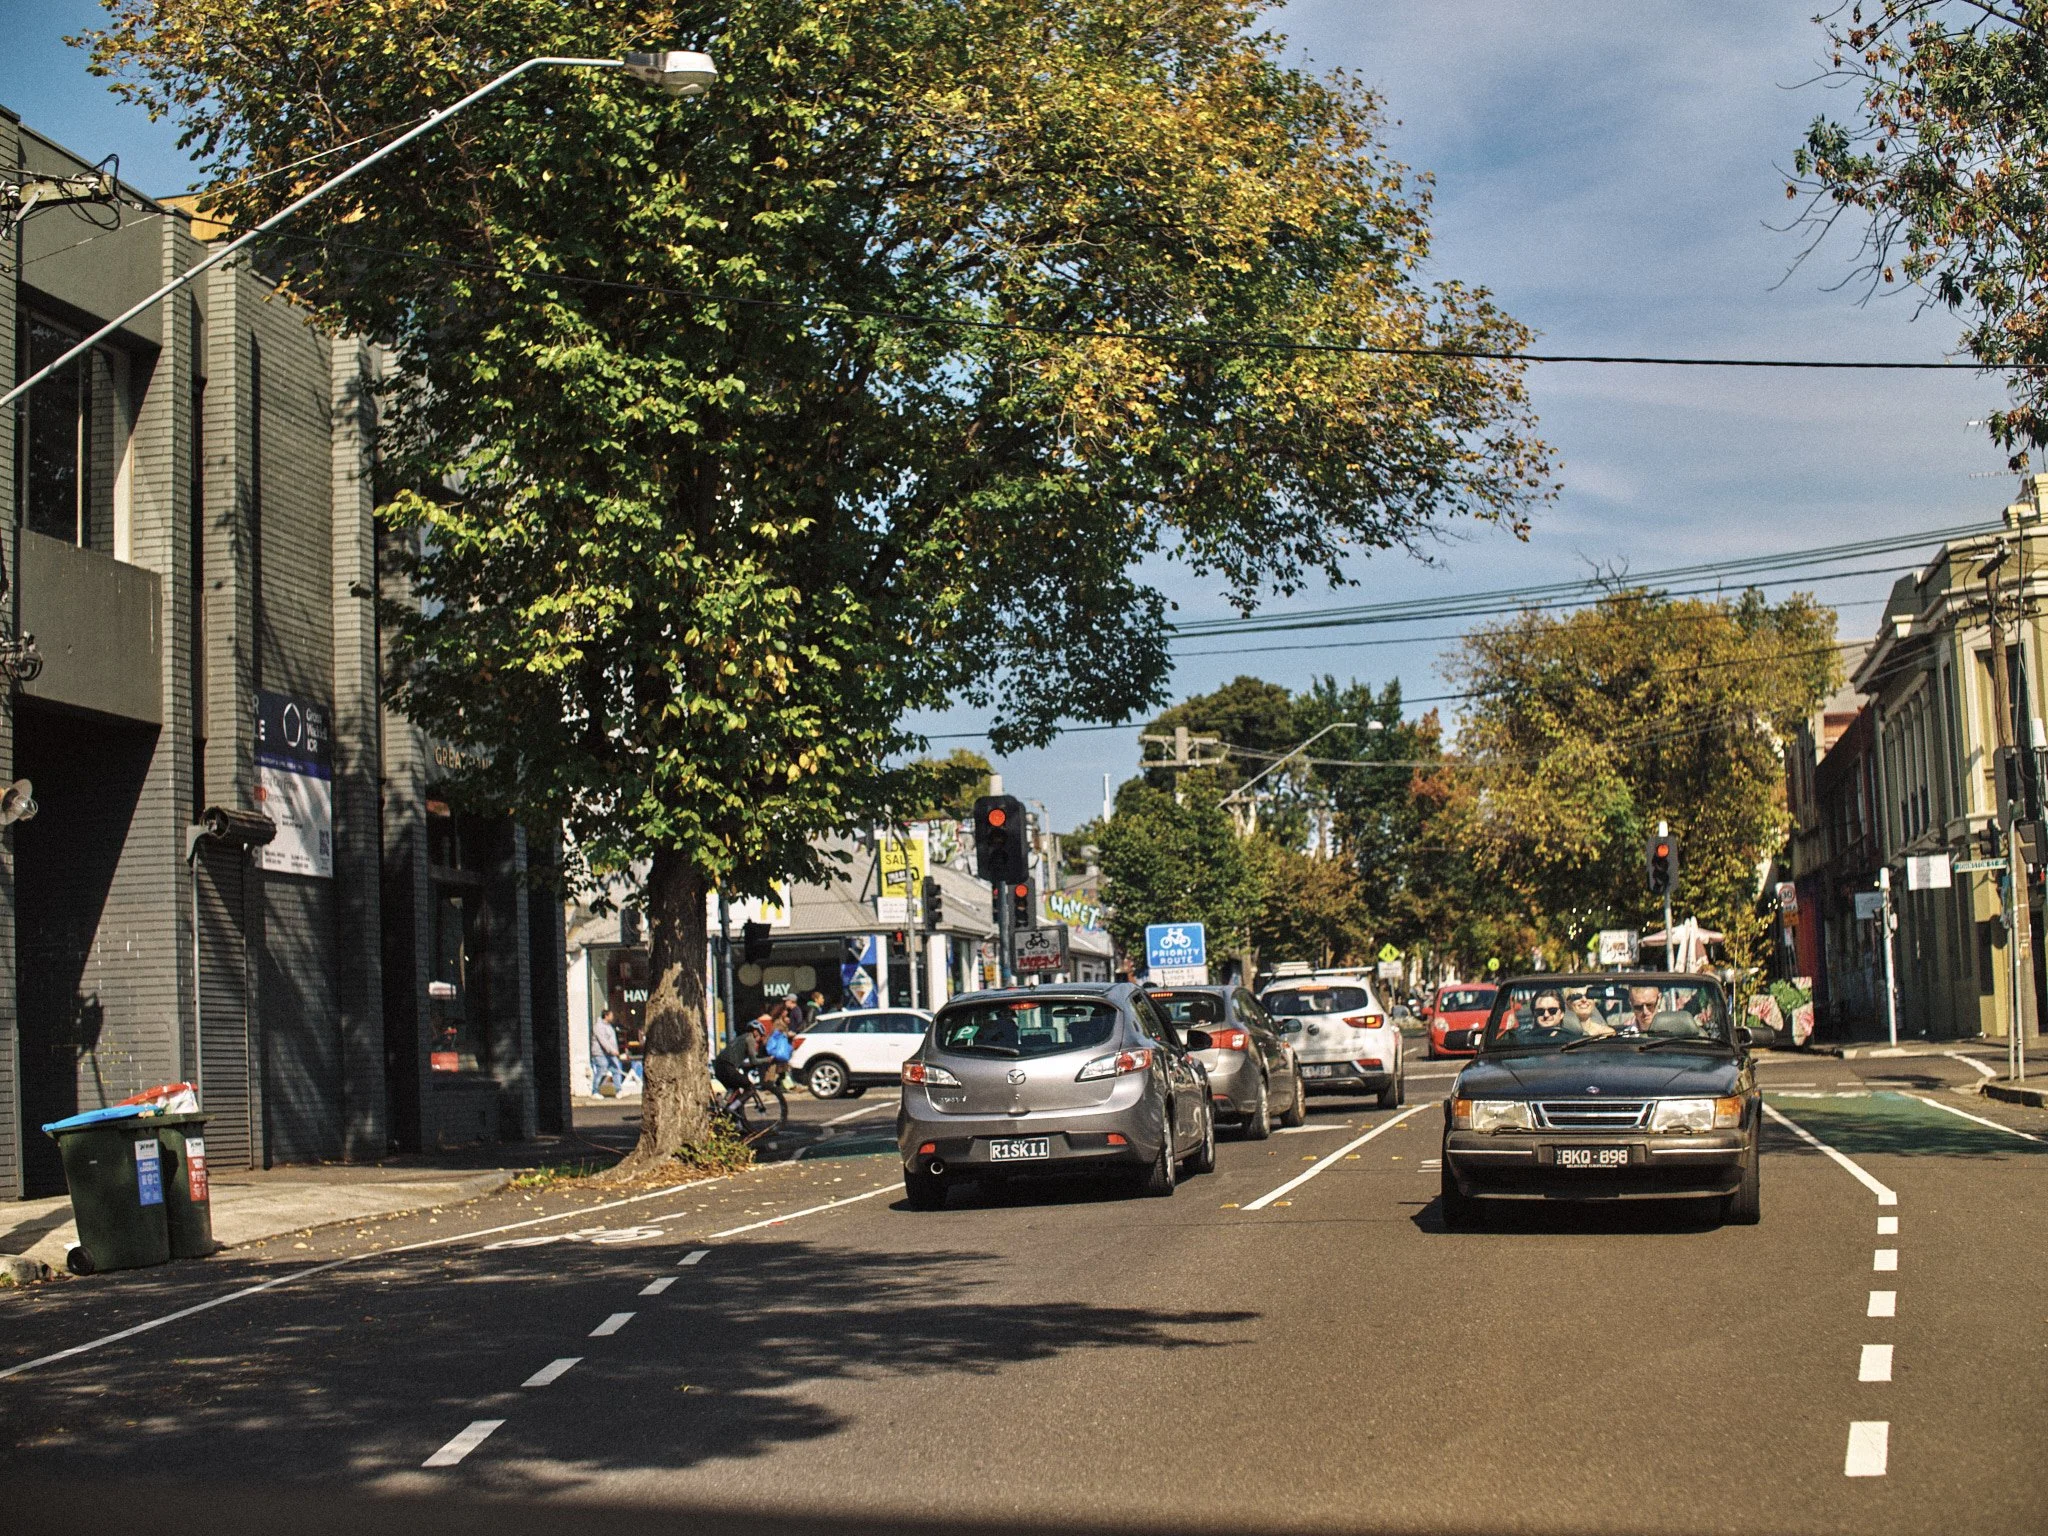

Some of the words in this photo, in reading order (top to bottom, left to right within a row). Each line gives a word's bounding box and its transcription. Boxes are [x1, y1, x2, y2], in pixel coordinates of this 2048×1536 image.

[885, 854, 913, 865] SALE
[1152, 948, 1200, 957] PRIORITY
[1160, 956, 1193, 964] ROUTE
[764, 983, 791, 997] HAY
[623, 989, 648, 1003] HAY
